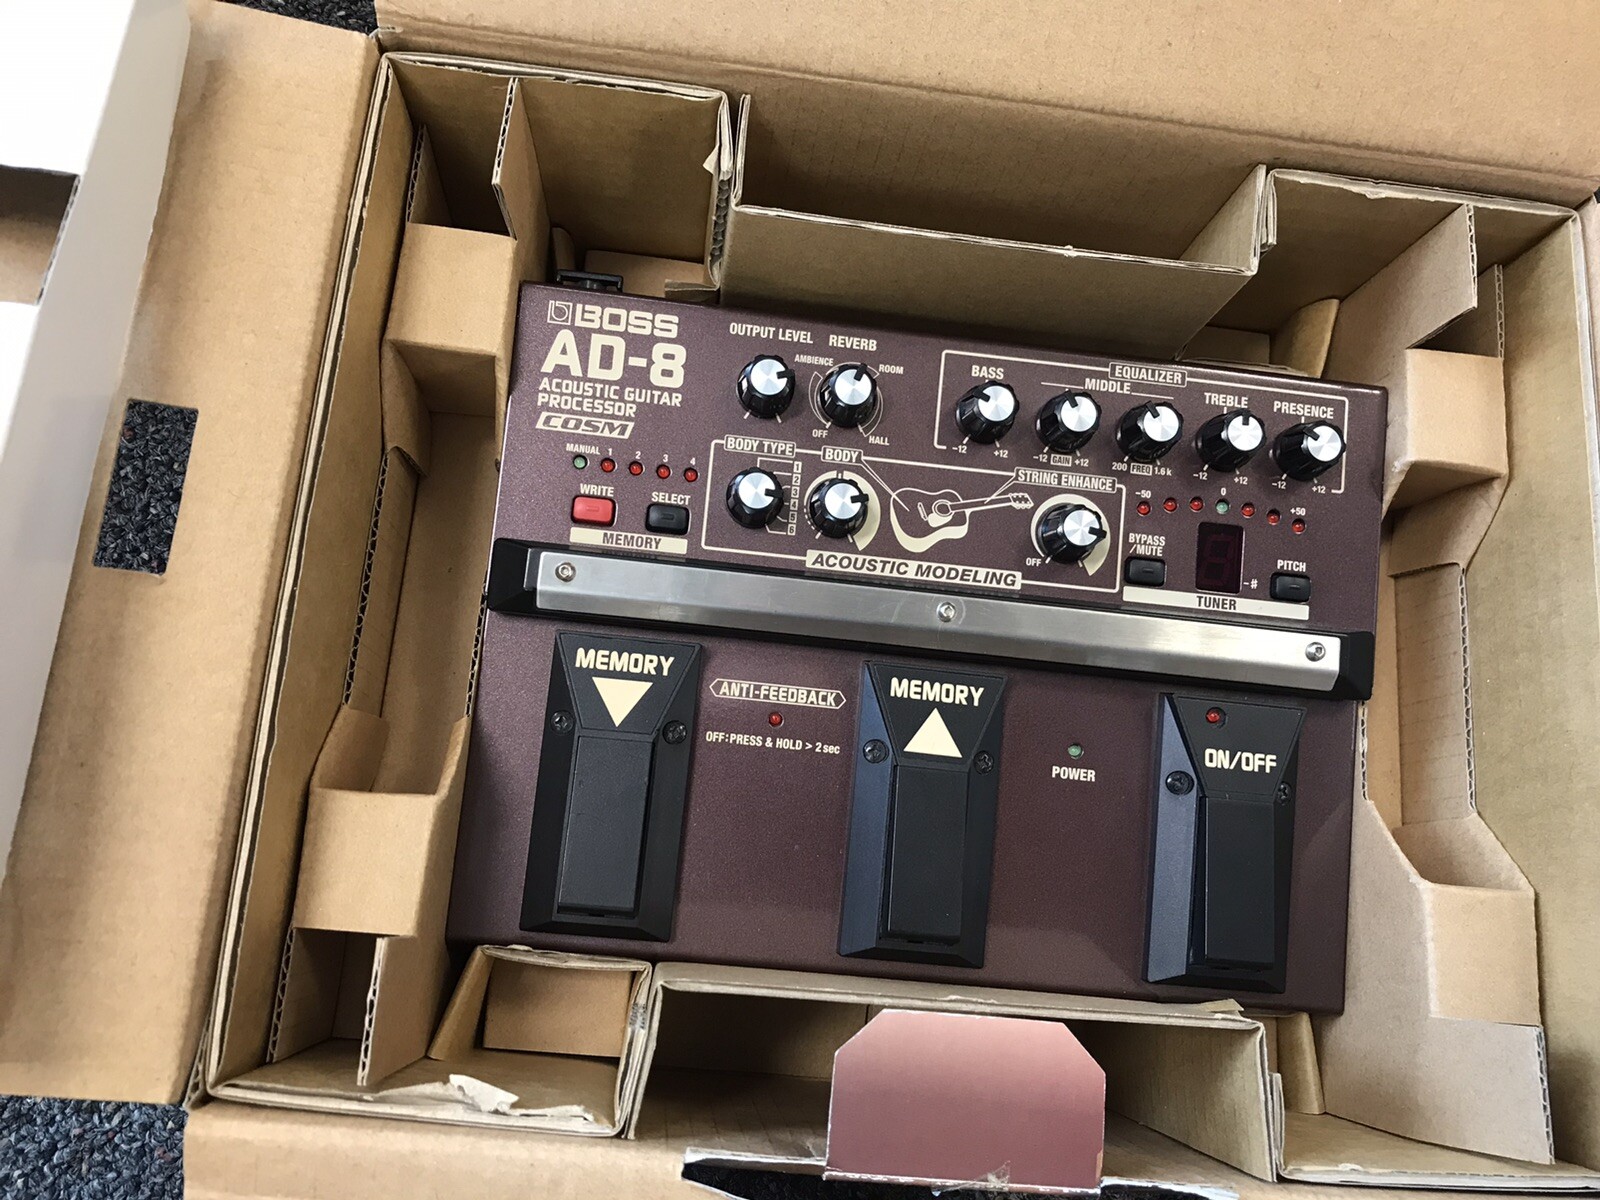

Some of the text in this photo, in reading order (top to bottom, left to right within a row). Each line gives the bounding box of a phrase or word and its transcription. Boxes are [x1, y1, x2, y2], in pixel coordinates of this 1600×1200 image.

[575, 303, 679, 338] BOSS
[729, 322, 813, 344] OUTPUT LEVEL
[829, 335, 877, 351] REVERB
[540, 329, 686, 388] AD-8
[794, 354, 834, 366] AMBIENCE
[879, 364, 904, 374] ROOM
[972, 365, 1004, 379] BASS
[1115, 366, 1182, 384] EQUALIZER
[538, 377, 682, 407] ACOUSTIC GUITAR
[1085, 378, 1131, 394] MIDDLE
[537, 393, 637, 418] PROCESSOR
[1204, 392, 1248, 408] TREBLE
[1274, 401, 1334, 419] PRESENCE
[542, 415, 629, 437] COSM
[812, 429, 828, 438] OFF
[727, 438, 793, 456] BODY TYPE
[869, 436, 889, 445] HALL
[566, 443, 600, 455] MANUAL
[608, 448, 612, 456] 1
[636, 451, 641, 459] 2
[825, 449, 858, 462] BODY
[952, 445, 967, 453] -12
[994, 449, 1008, 458] +12
[663, 454, 668, 462] 3
[1033, 454, 1089, 466] -12 GAIN +12
[795, 463, 800, 471] 1
[1112, 462, 1127, 471] 200
[1132, 465, 1150, 474] FREQ
[1018, 470, 1112, 490] STRING ENHANCE
[1193, 472, 1207, 480] -12
[1234, 476, 1248, 485] +12
[580, 483, 614, 497] WRITE
[1272, 481, 1286, 489] -12
[1312, 485, 1326, 494] +12
[652, 492, 691, 505] SELECT
[1135, 490, 1151, 498] -50
[1290, 508, 1306, 516] +50
[602, 532, 661, 549] MEMORY
[1129, 533, 1165, 546] BYPASS
[1129, 544, 1163, 556] /MUTE
[1026, 557, 1041, 567] OFF
[1277, 559, 1306, 572] PITCH
[811, 553, 1017, 586] ACOUSTIC MODELING
[1196, 596, 1236, 610] TUNER
[575, 647, 675, 676] MEMORY
[719, 681, 836, 706] ANTI-FEEDBACK
[889, 677, 985, 707] MEMORY
[765, 737, 773, 747] &
[776, 739, 802, 750] HOLD
[1205, 748, 1276, 773] ON/OFF
[1052, 765, 1095, 782] POWER
